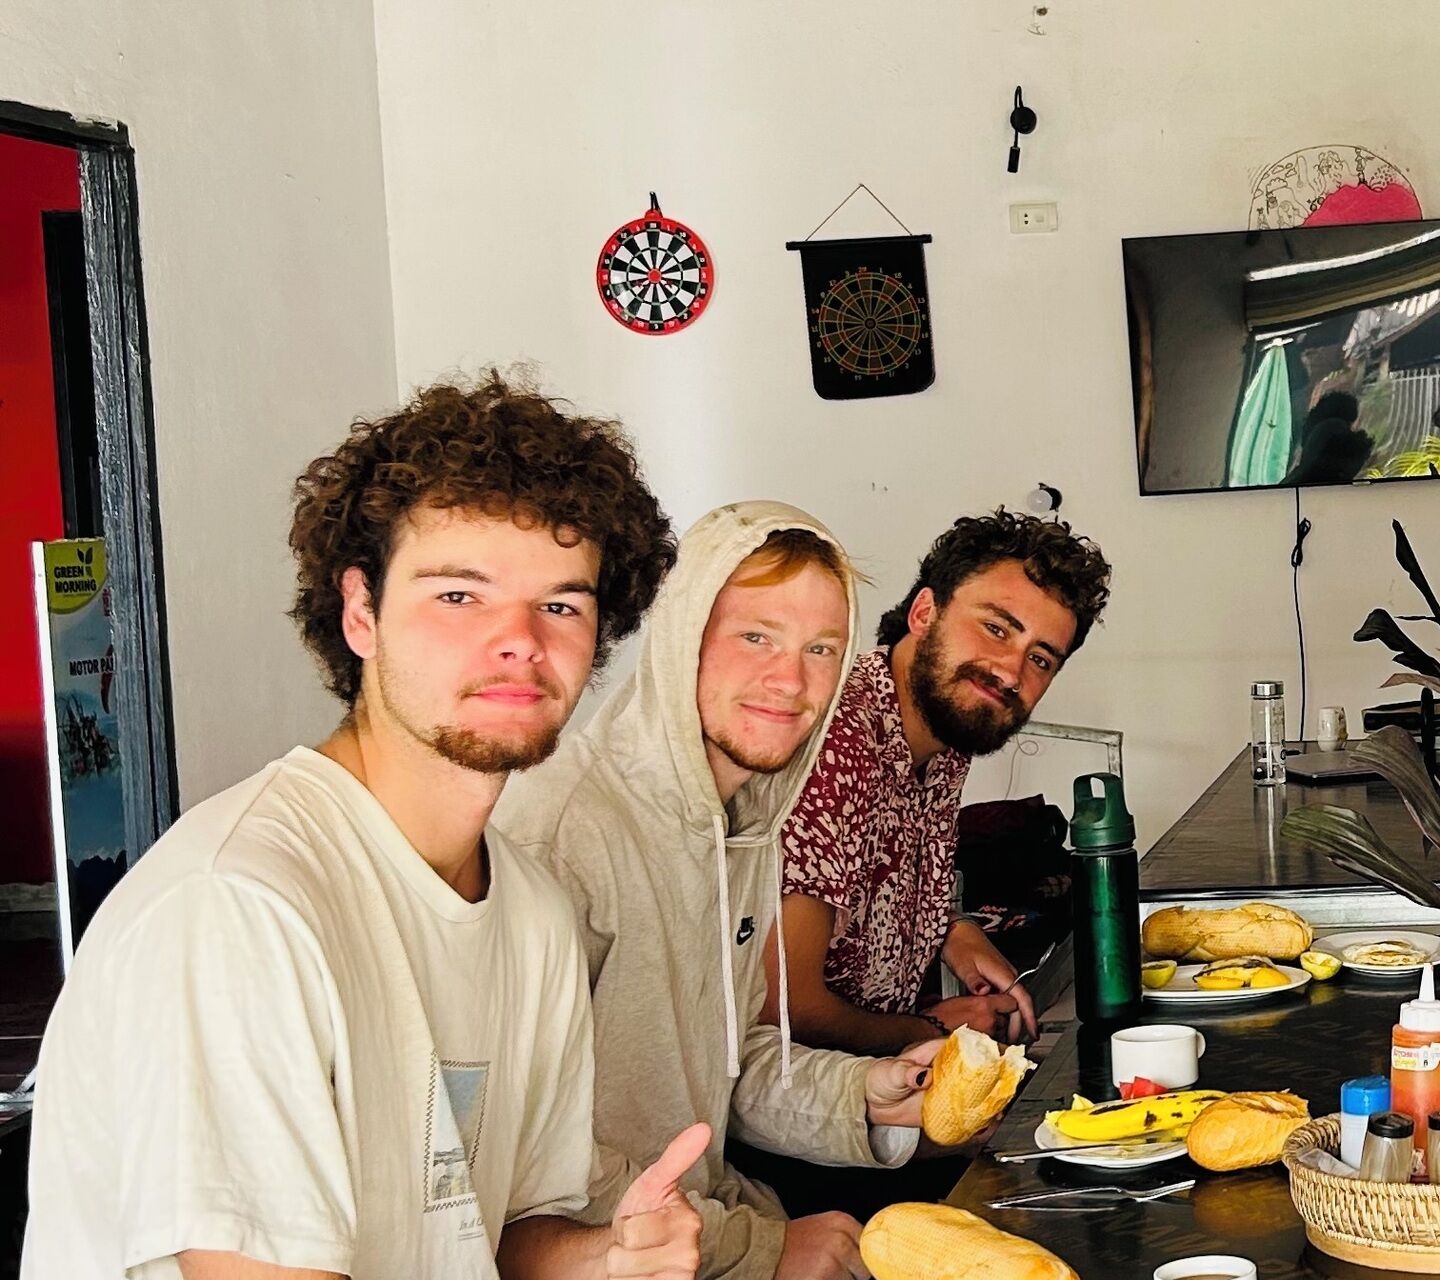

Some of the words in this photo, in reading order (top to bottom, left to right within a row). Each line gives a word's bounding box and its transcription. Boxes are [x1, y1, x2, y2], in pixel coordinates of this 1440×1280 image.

[54, 566, 84, 579] GREEN
[55, 579, 97, 593] MORNING
[69, 660, 99, 677] MOTOR
